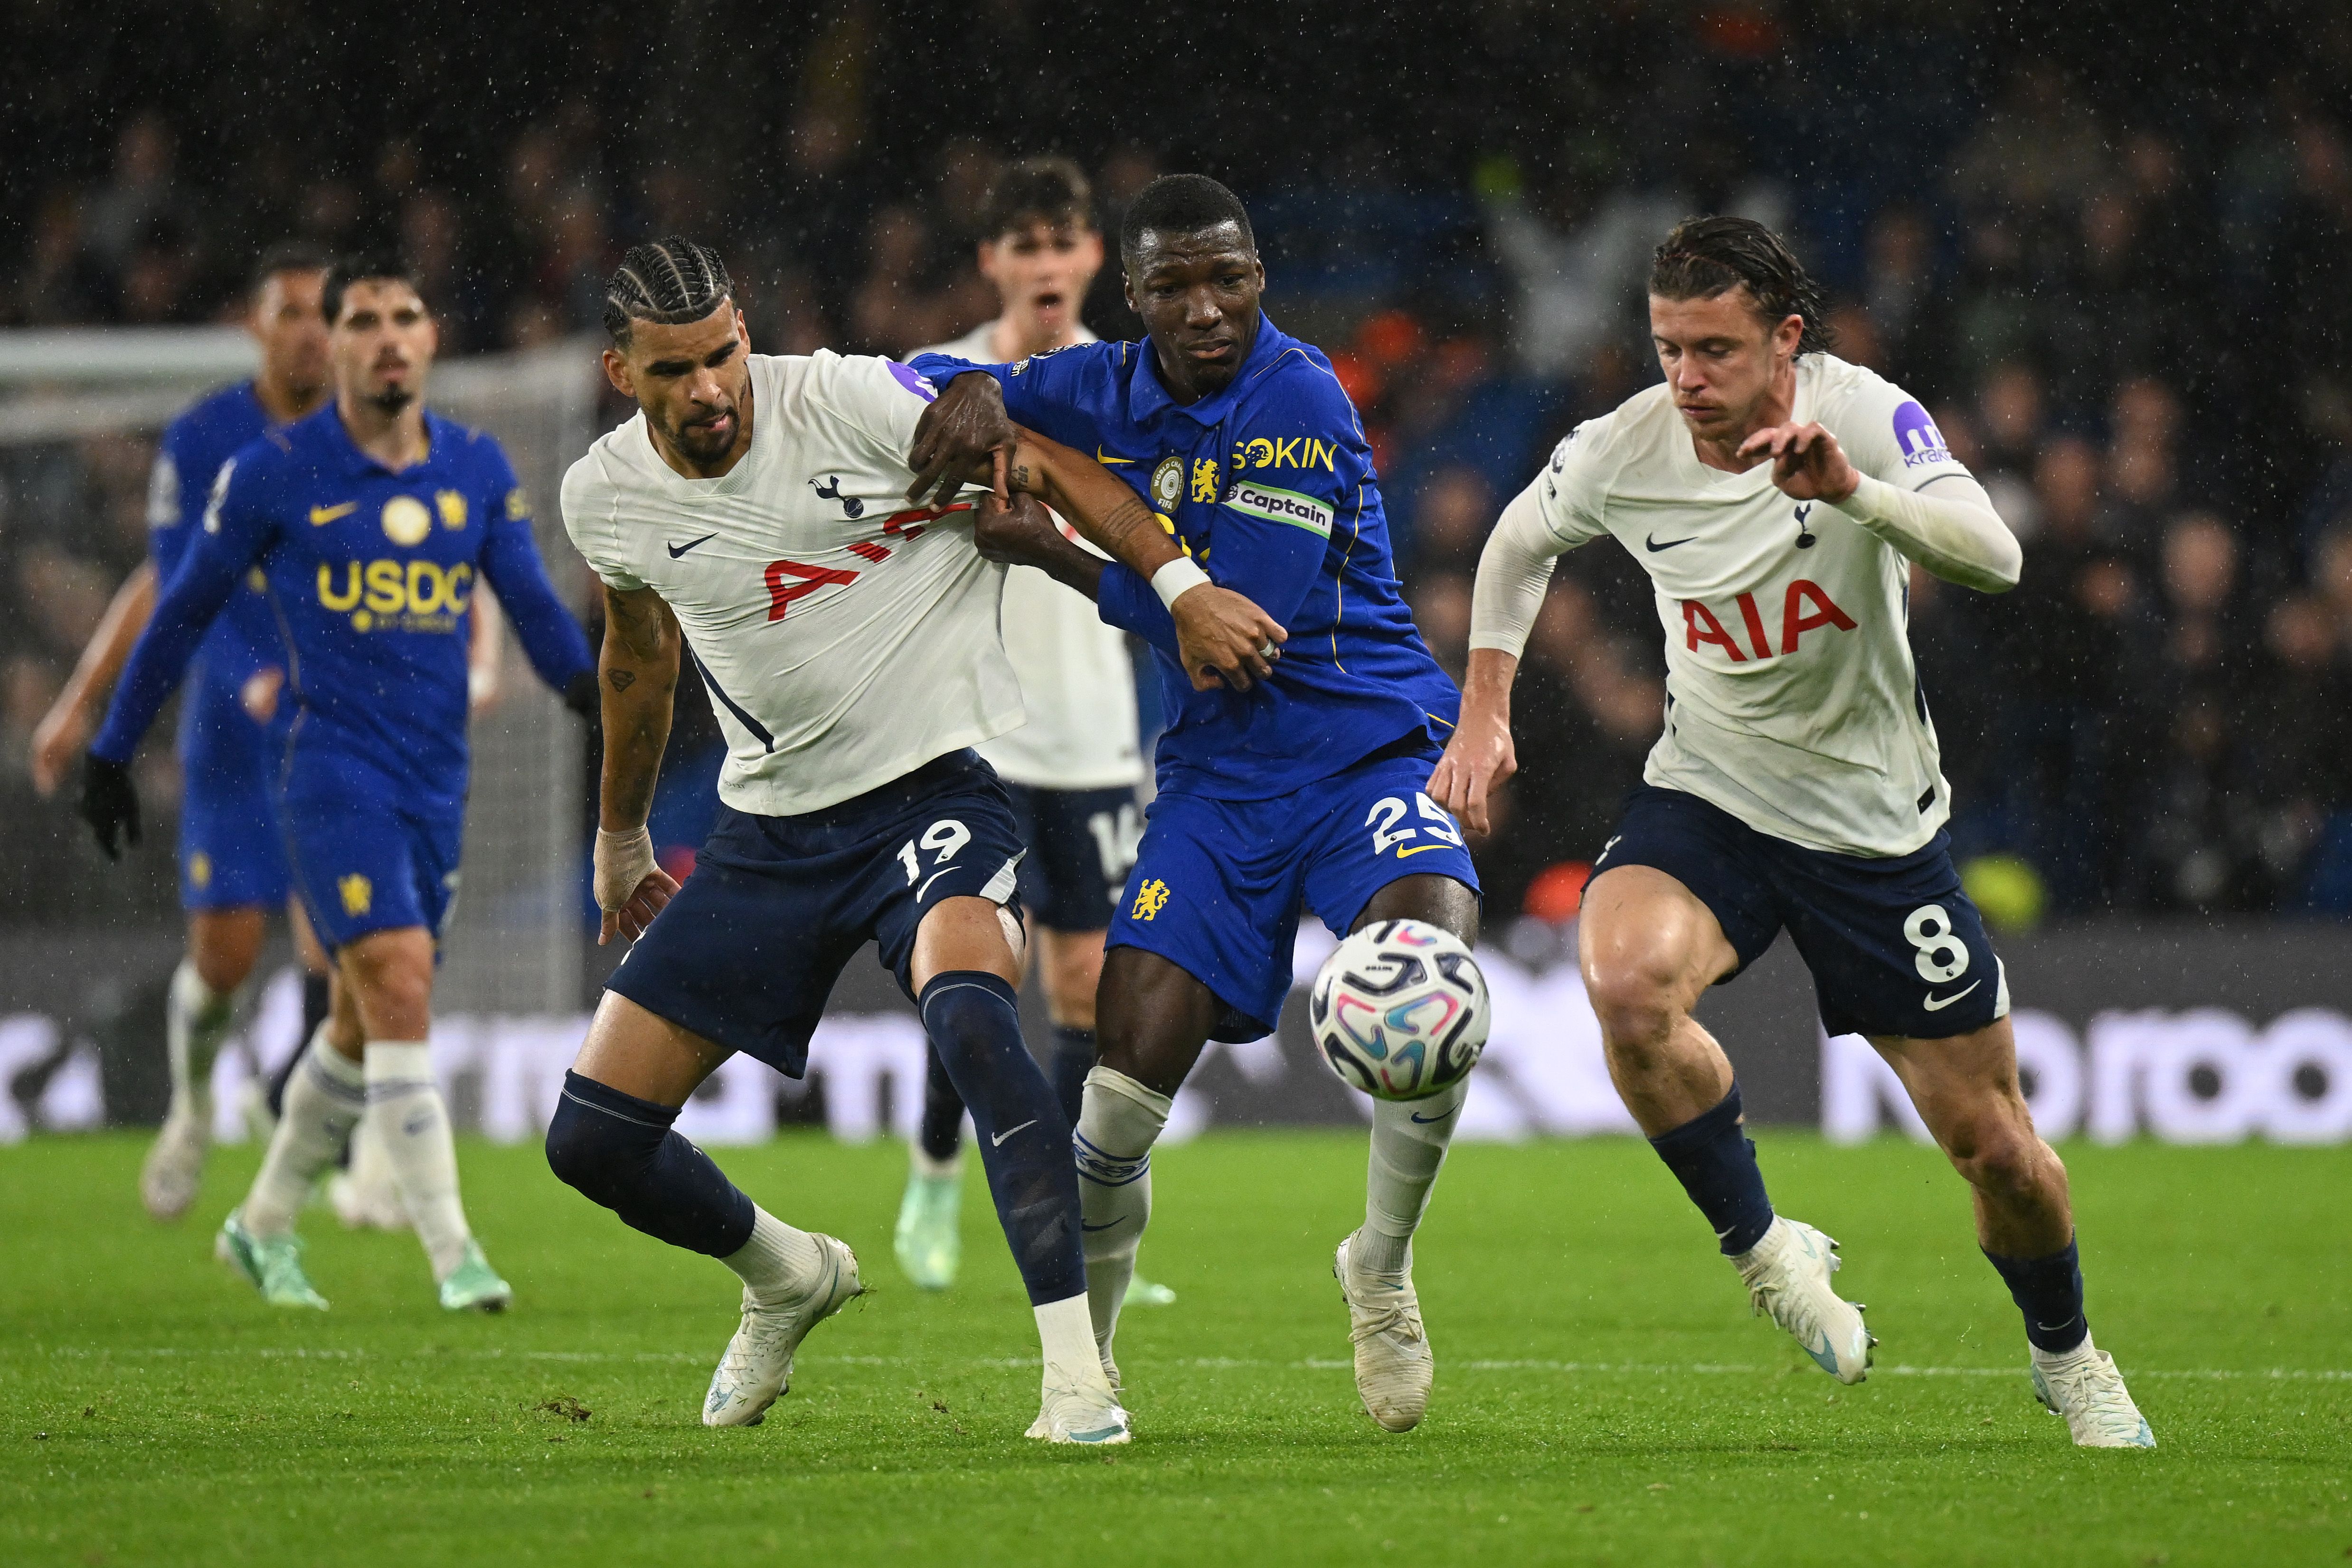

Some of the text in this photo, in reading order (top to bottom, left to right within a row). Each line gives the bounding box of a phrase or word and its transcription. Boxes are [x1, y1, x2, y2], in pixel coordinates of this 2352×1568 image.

[1154, 463, 1170, 487] WORLD
[1232, 437, 1338, 472] SOKIN
[1904, 448, 1951, 468] krak
[1158, 498, 1173, 510] FIFA
[317, 559, 471, 614] USDC
[1681, 579, 1859, 662] AIA
[1364, 792, 1464, 855] 25
[897, 819, 971, 887] 19
[1903, 904, 1970, 983] 8
